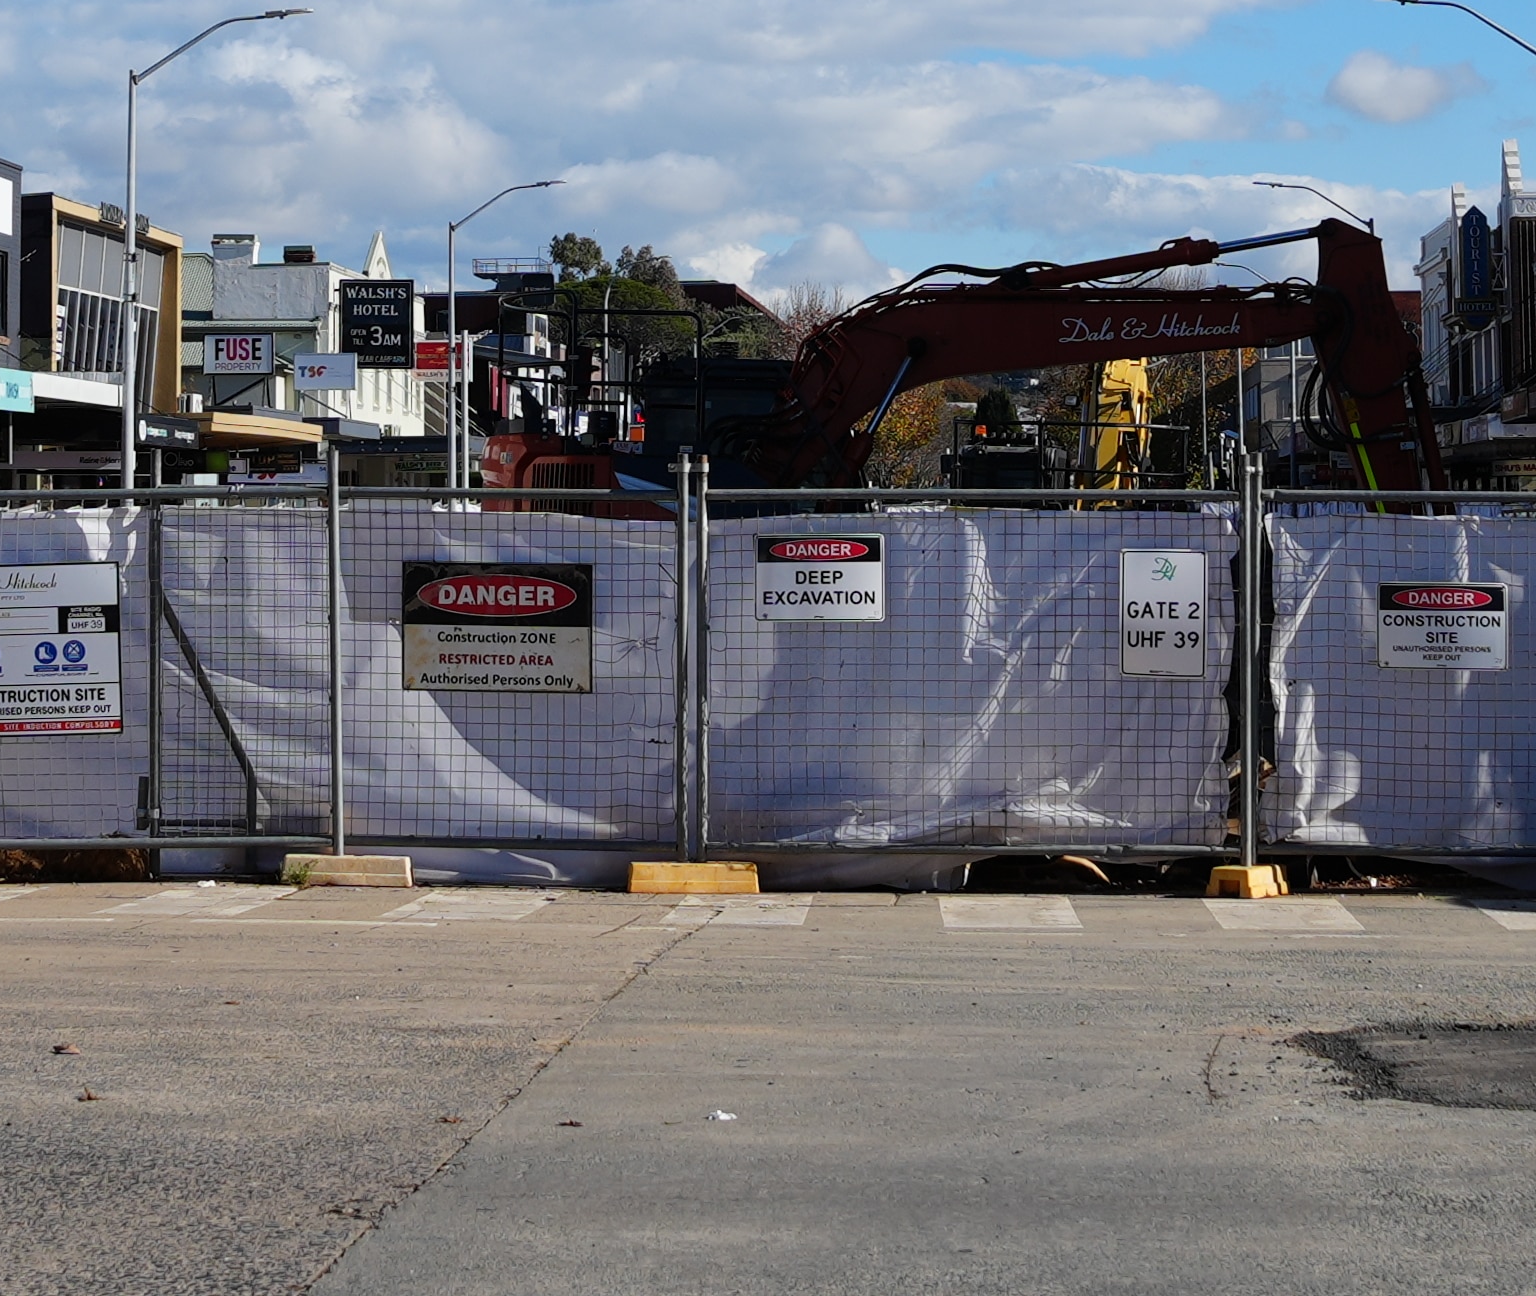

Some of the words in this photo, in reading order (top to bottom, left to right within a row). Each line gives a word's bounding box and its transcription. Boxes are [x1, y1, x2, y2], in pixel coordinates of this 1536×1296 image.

[1469, 214, 1482, 296] TOURIST
[345, 285, 407, 299] WALSH'S
[353, 304, 399, 317] HOTEL
[1458, 302, 1496, 312] HOTEL
[350, 328, 367, 336] OPEN
[1058, 316, 1115, 343] Dale
[1120, 317, 1148, 340] &
[1142, 311, 1241, 339] Hitchcock
[215, 337, 263, 361] FUSE
[215, 362, 263, 372] PROPERTY
[1494, 464, 1521, 473] SHU'S
[785, 543, 852, 557] DANGER
[0, 572, 57, 590] Hitchcock
[795, 570, 844, 585] DEEP
[438, 585, 555, 606] DANGER
[763, 590, 876, 606] EXCAVATION
[1408, 591, 1476, 605] DANGER
[1126, 601, 1180, 619] GATE
[1187, 602, 1200, 619] 2
[71, 621, 88, 630] UHF
[90, 619, 103, 629] 39
[1382, 614, 1502, 629] CONSTRUCTION
[437, 630, 517, 645] Construction
[519, 632, 557, 645] ZONE
[1127, 631, 1166, 648] UHF
[1173, 631, 1200, 649] 39
[1425, 631, 1458, 645] SITE
[1392, 645, 1452, 653] UNAUTHORISED
[1453, 645, 1492, 653] PERSONS
[438, 653, 515, 666] RESTRICTED
[518, 654, 554, 667] AREA
[1422, 654, 1443, 662] KEEP
[1444, 654, 1462, 662] OUT
[420, 672, 490, 686] Authorised
[492, 674, 542, 687] Persons
[544, 674, 574, 689] Only
[75, 688, 106, 702] SITE
[24, 705, 66, 715] PERSONS
[68, 705, 92, 714] KEEP
[93, 704, 112, 714] OUT
[4, 723, 19, 731] SITE
[23, 722, 62, 731] INDUCTION
[64, 721, 115, 730] COMPULSORY
